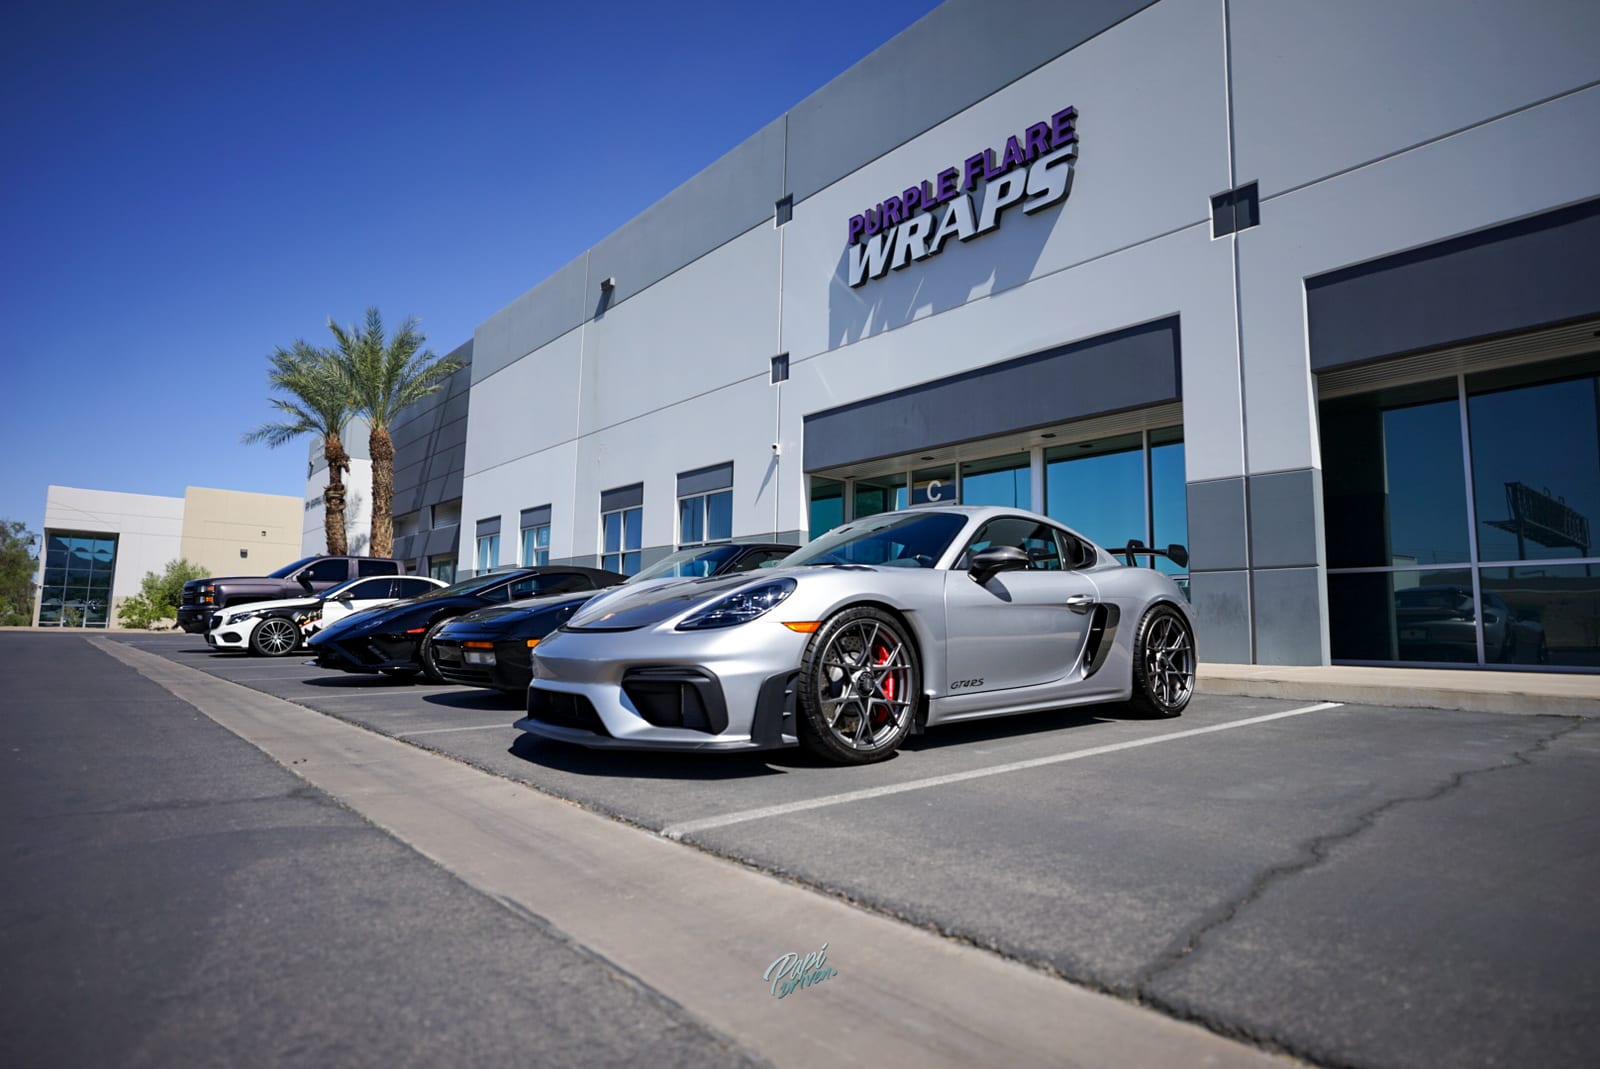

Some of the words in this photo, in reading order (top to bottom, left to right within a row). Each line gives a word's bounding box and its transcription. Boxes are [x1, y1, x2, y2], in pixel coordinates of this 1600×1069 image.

[848, 166, 959, 245] PURPLE
[964, 105, 1079, 191] FLARE
[848, 142, 1078, 288] WRAPS
[927, 480, 942, 501] C
